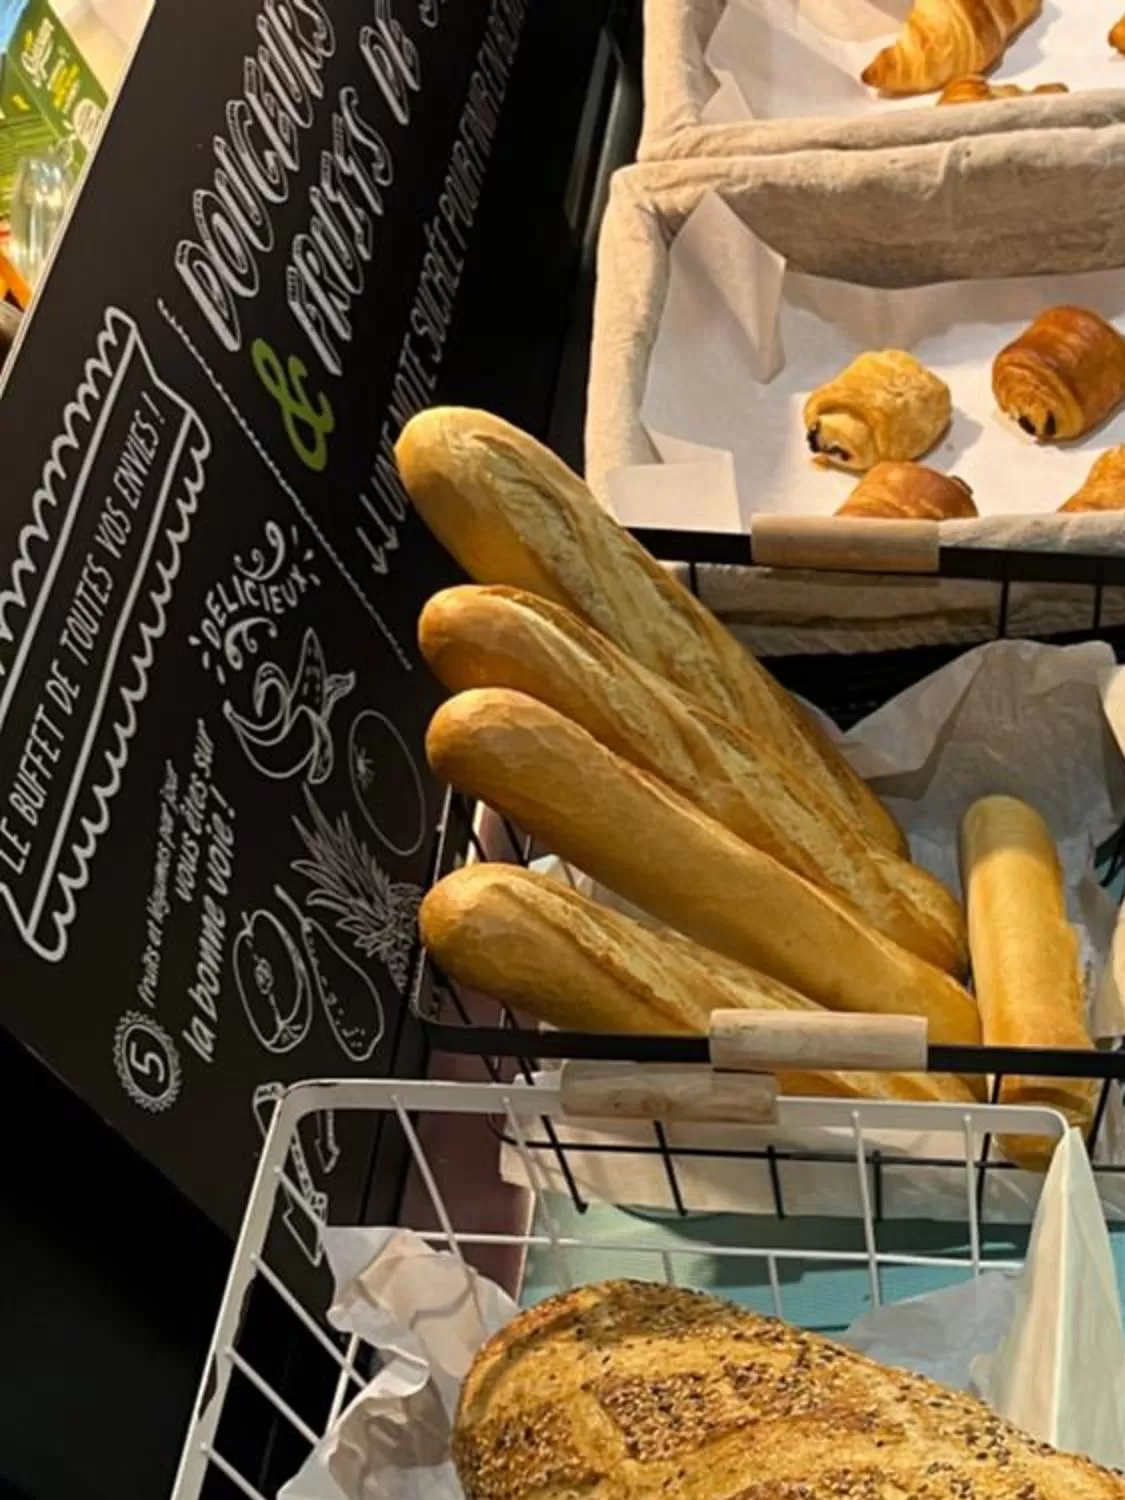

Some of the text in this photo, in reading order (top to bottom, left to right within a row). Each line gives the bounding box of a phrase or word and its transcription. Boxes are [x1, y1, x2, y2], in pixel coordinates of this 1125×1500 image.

[252, 0, 421, 472] & FRUITS DE
[95, 496, 132, 559] VOS
[60, 552, 113, 666] TOUTES
[200, 563, 308, 650] DELICIEUX
[45, 659, 80, 716] DE
[9, 703, 64, 828] BUFFET
[0, 816, 31, 875] LE
[158, 801, 177, 850] par
[175, 718, 215, 902] vous êtes sur
[188, 896, 227, 1022] bonne
[130, 1040, 166, 1084] 5
[183, 1016, 217, 1063] la
